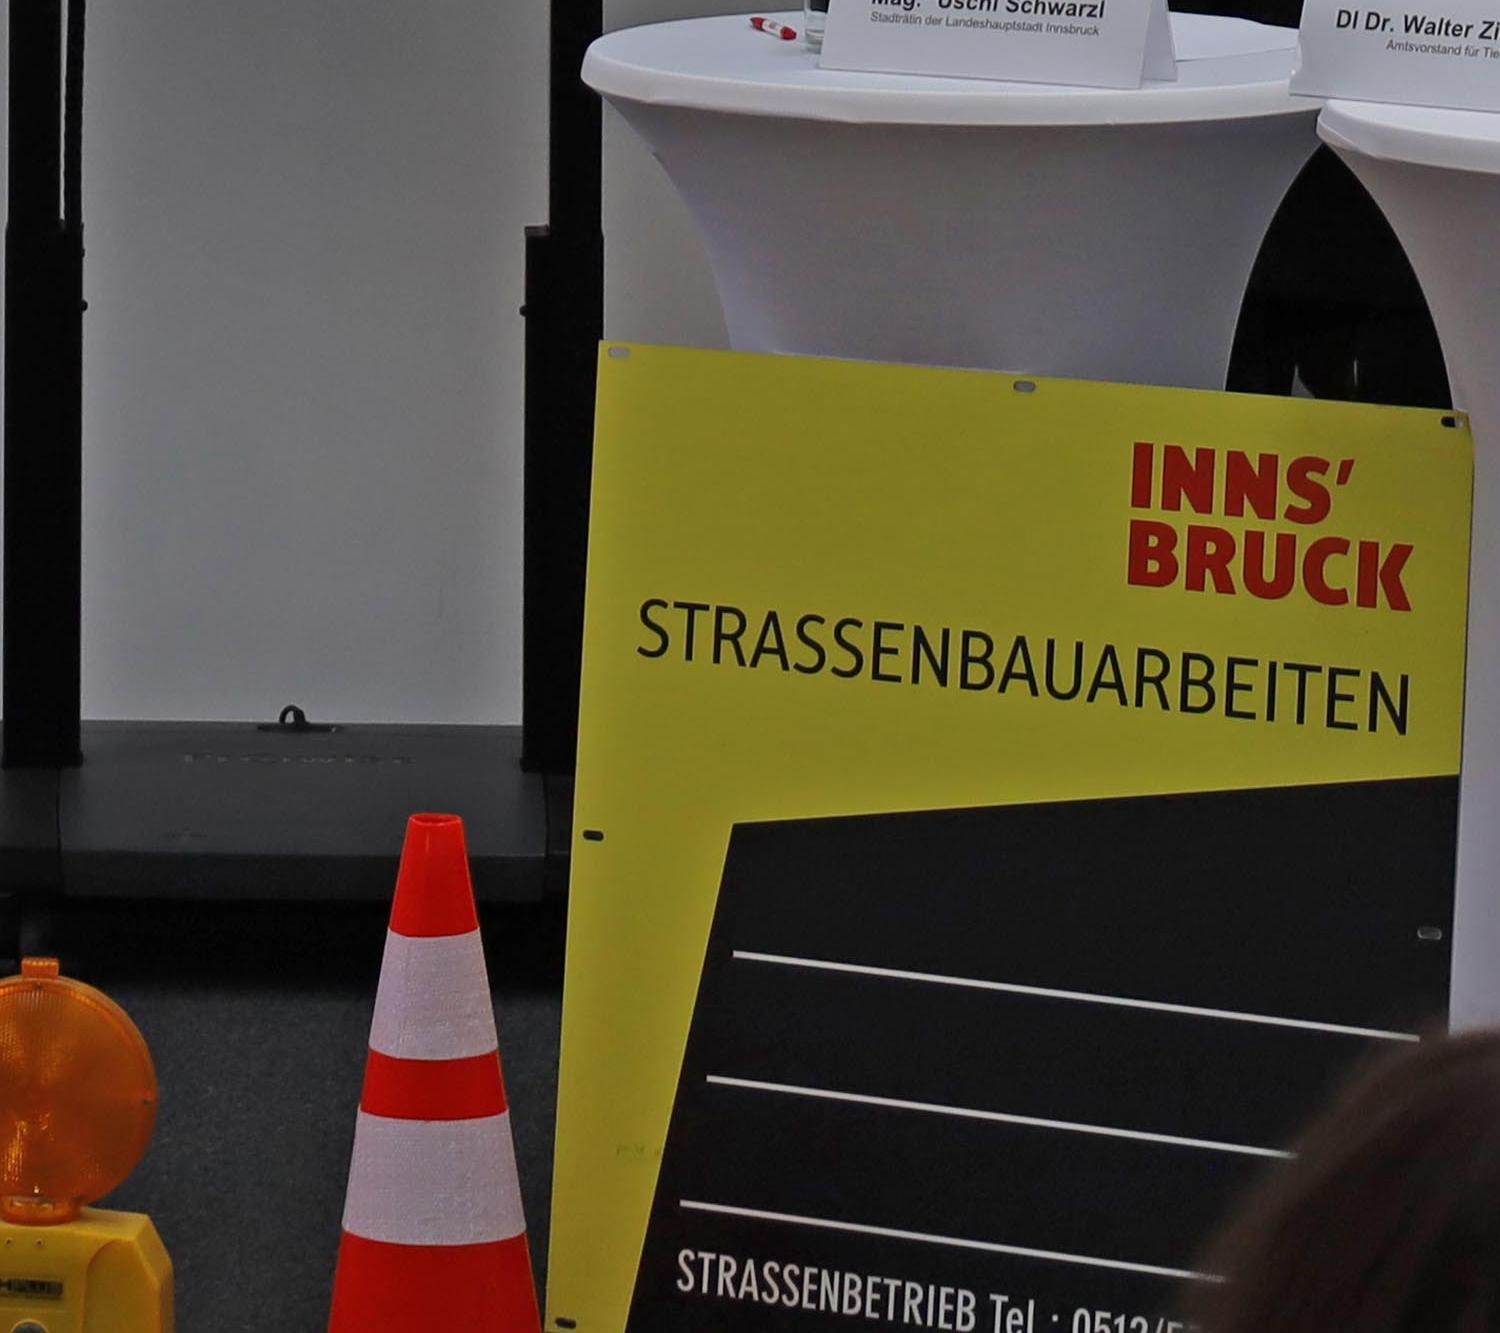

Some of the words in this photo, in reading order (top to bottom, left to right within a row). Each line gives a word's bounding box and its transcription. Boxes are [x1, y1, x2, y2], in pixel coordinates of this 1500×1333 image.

[870, 11, 922, 26] Stadträtin
[925, 14, 943, 26] der
[945, 16, 1043, 34] Landeshauptstadt
[1045, 22, 1100, 36] Innsbruck
[1336, 9, 1359, 30] DI
[1364, 12, 1394, 32] Dr.
[1403, 14, 1473, 39] Walter
[1386, 39, 1461, 57] Amtsvorstand
[1464, 45, 1480, 58] für
[1131, 441, 1355, 525] INNS'
[1127, 519, 1414, 612] BRUCK
[636, 598, 1409, 736] STRASSENBAUARBEITEN
[676, 1248, 977, 1332] STRASSENBETRIEB
